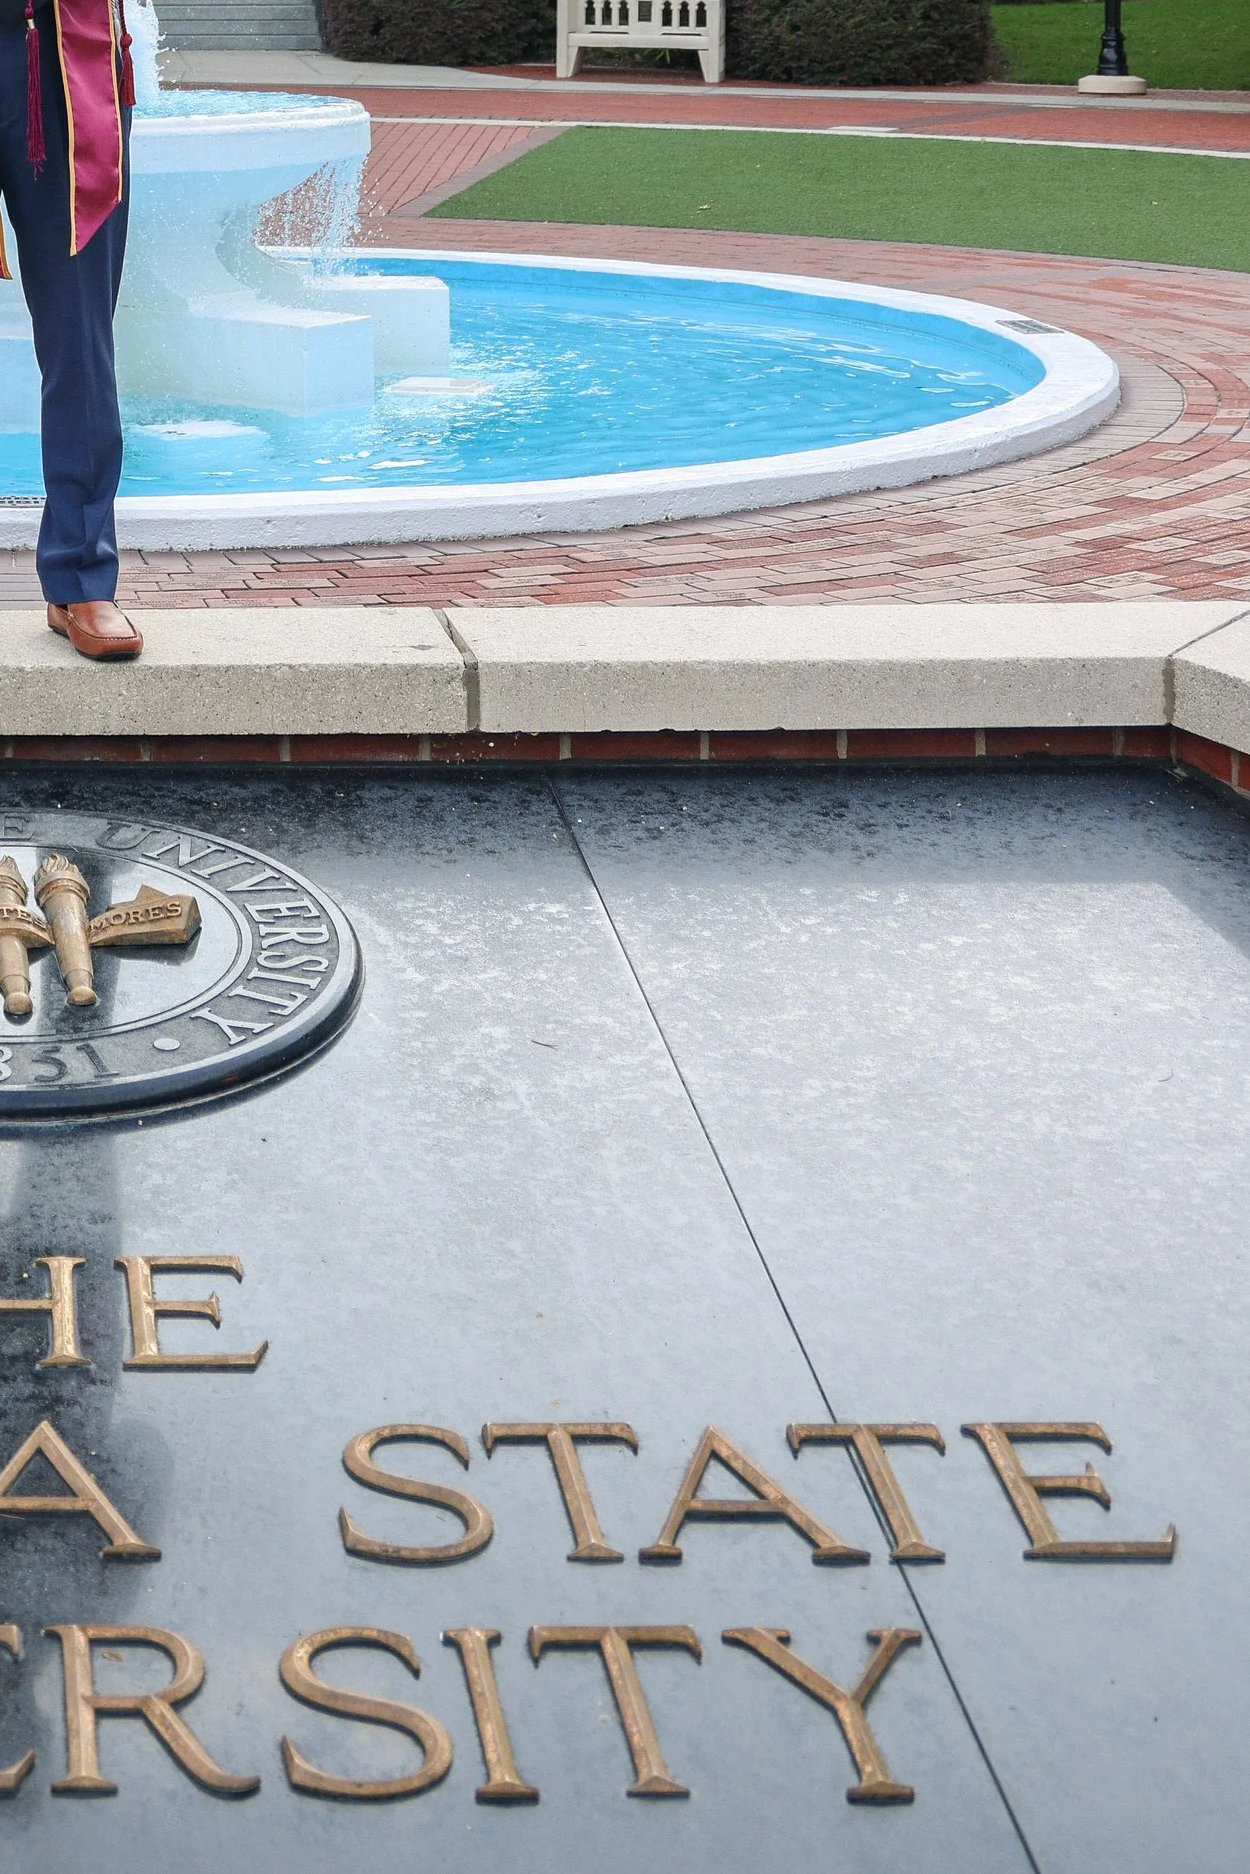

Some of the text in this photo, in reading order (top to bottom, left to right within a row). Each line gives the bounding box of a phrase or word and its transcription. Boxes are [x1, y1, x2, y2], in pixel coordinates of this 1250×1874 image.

[90, 901, 183, 932] MORES
[96, 820, 330, 1046] UNIVERSITY
[337, 1421, 1178, 1565] STATE
